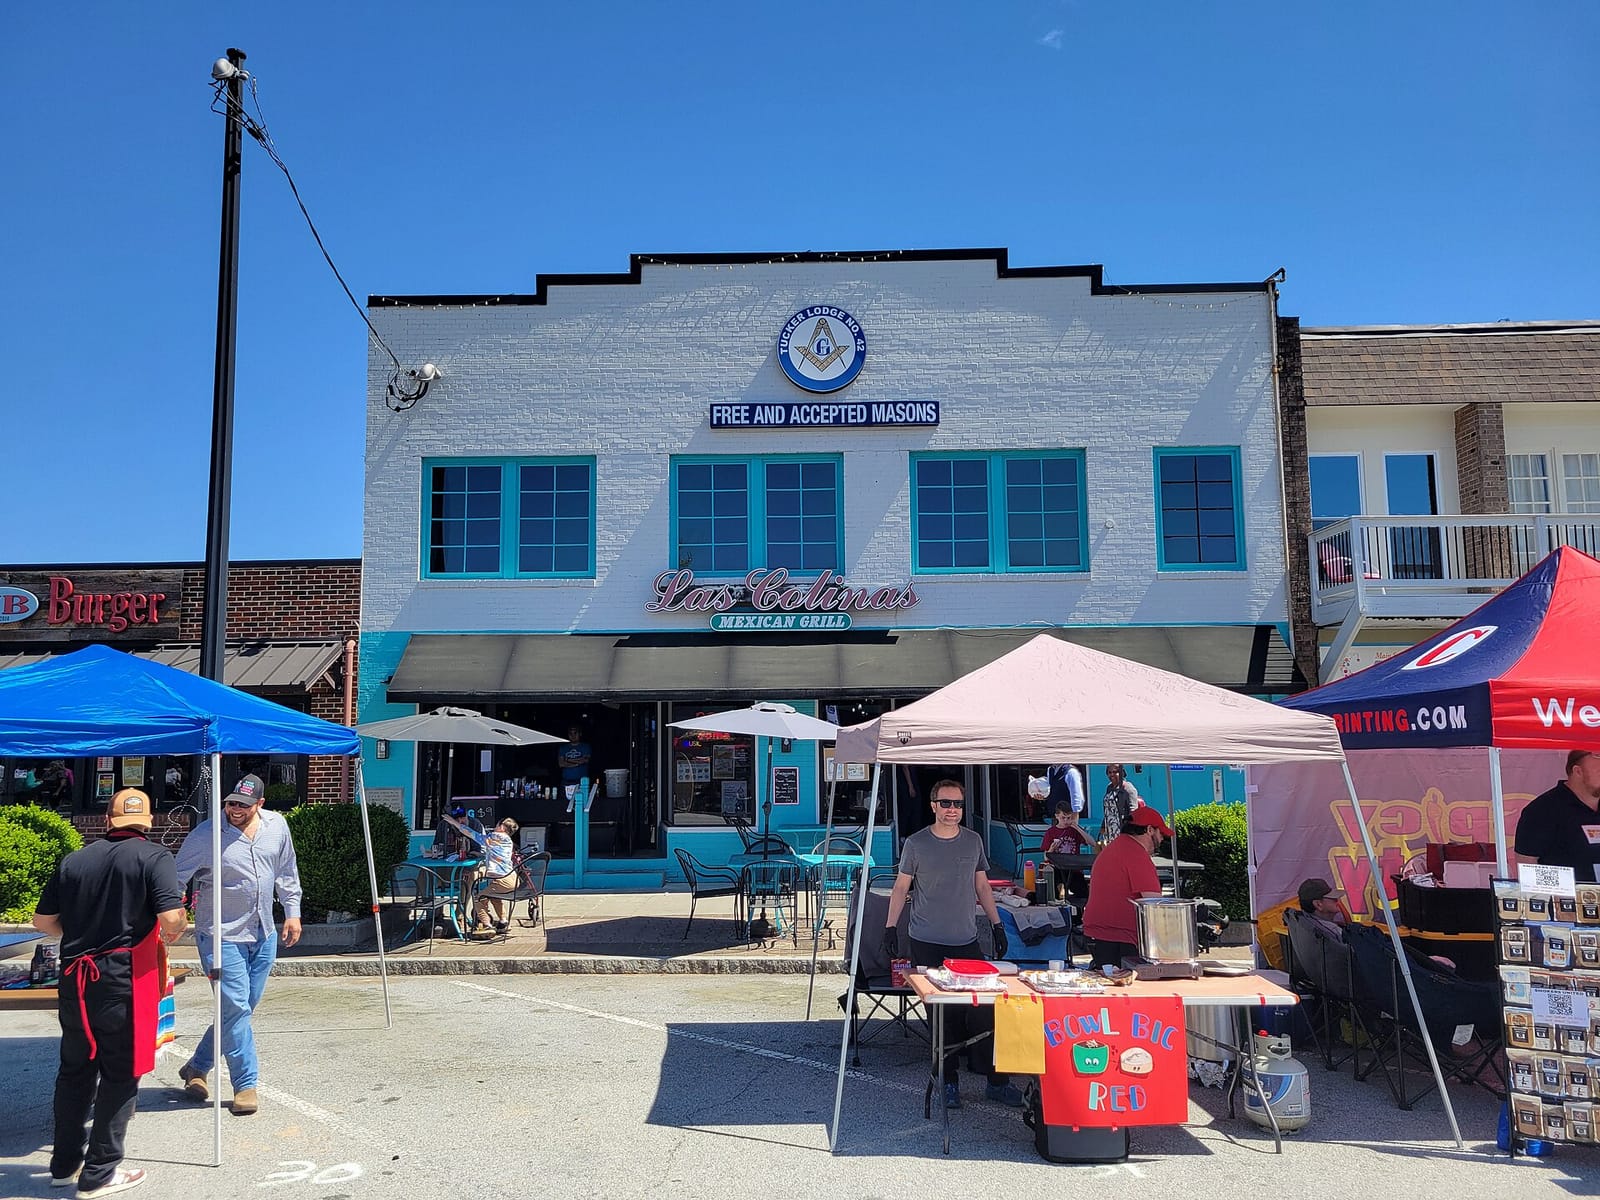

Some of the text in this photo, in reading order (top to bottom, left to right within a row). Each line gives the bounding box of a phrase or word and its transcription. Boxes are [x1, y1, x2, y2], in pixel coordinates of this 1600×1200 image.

[779, 306, 865, 354] TUCKER LODGE NO. 42
[712, 403, 937, 425] FREE AND ACCEPTED MASONS
[47, 576, 166, 633] Burger
[646, 567, 921, 612] Las Colinas
[718, 614, 846, 629] MEXICAN GRILL
[1334, 705, 1468, 735] RINTING.COM
[1044, 1007, 1120, 1048] BOWL
[1088, 1081, 1147, 1112] RED
